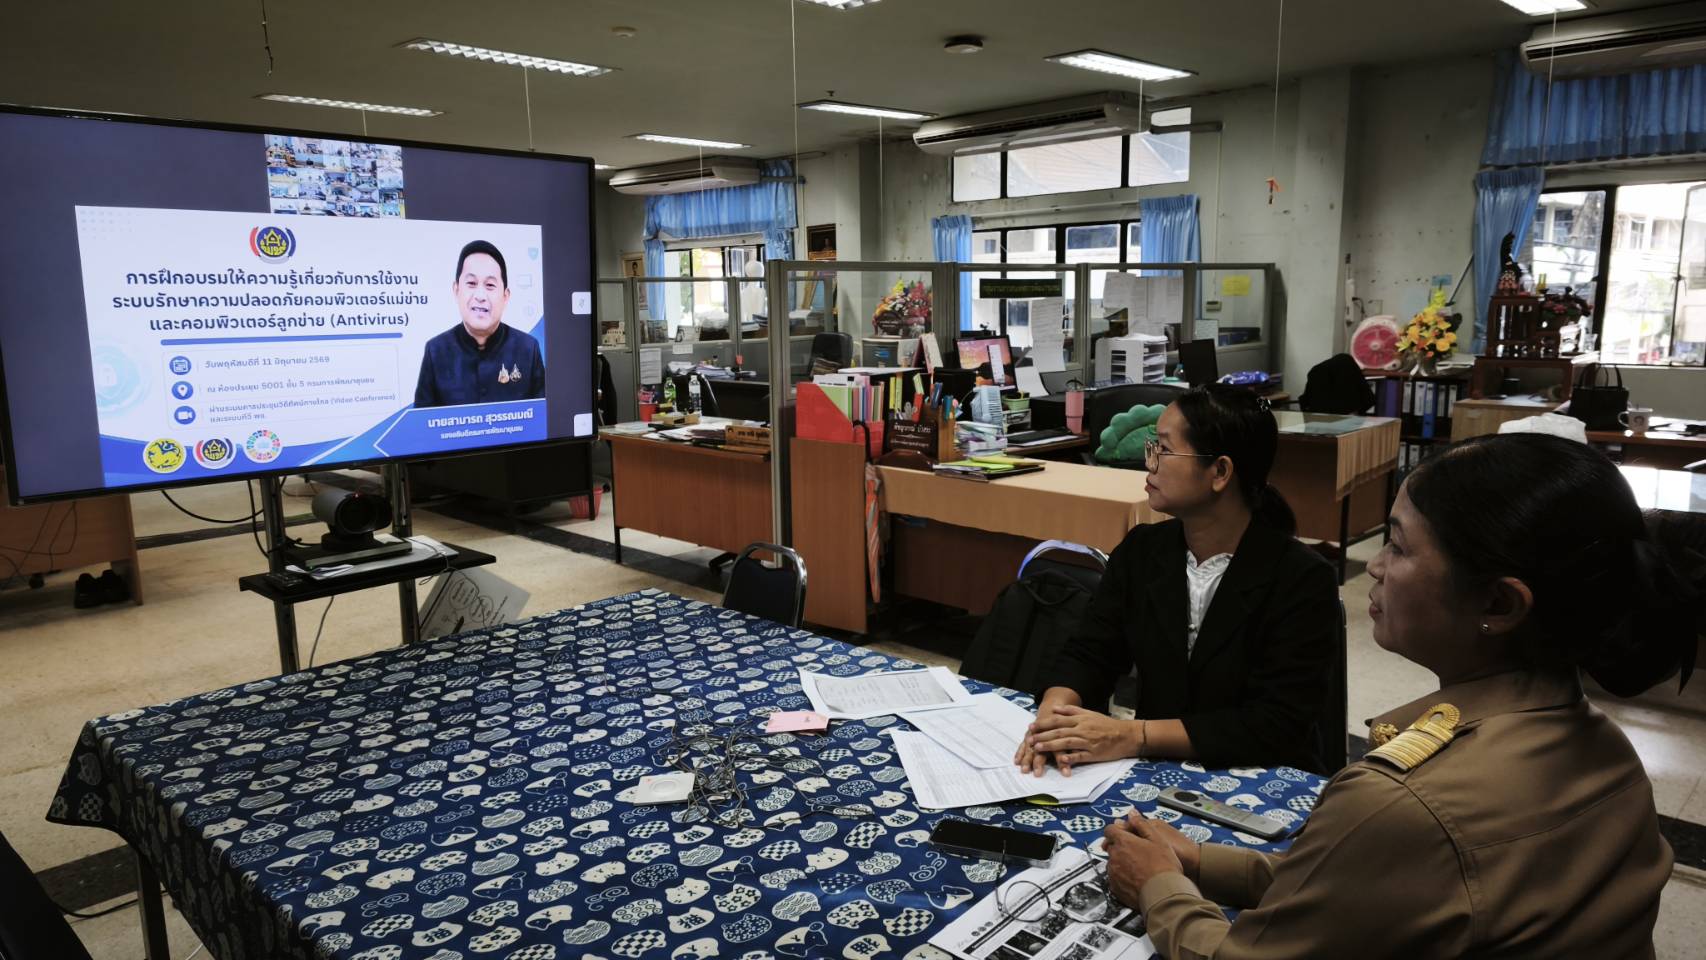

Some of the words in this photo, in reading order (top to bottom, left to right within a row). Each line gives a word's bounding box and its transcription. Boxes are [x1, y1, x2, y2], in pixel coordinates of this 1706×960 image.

[126, 267, 418, 289] การฝึกอบรมให้ความรู้เกี่ยวกับการใช้งาน
[113, 291, 428, 309] ระบบรักษาความปลอดภัยคอมพิวเตอร์แม่ข่าย
[150, 313, 325, 332] และคอมพิวเตอร์ลูกข่าย
[330, 312, 409, 328] (Antivirus)
